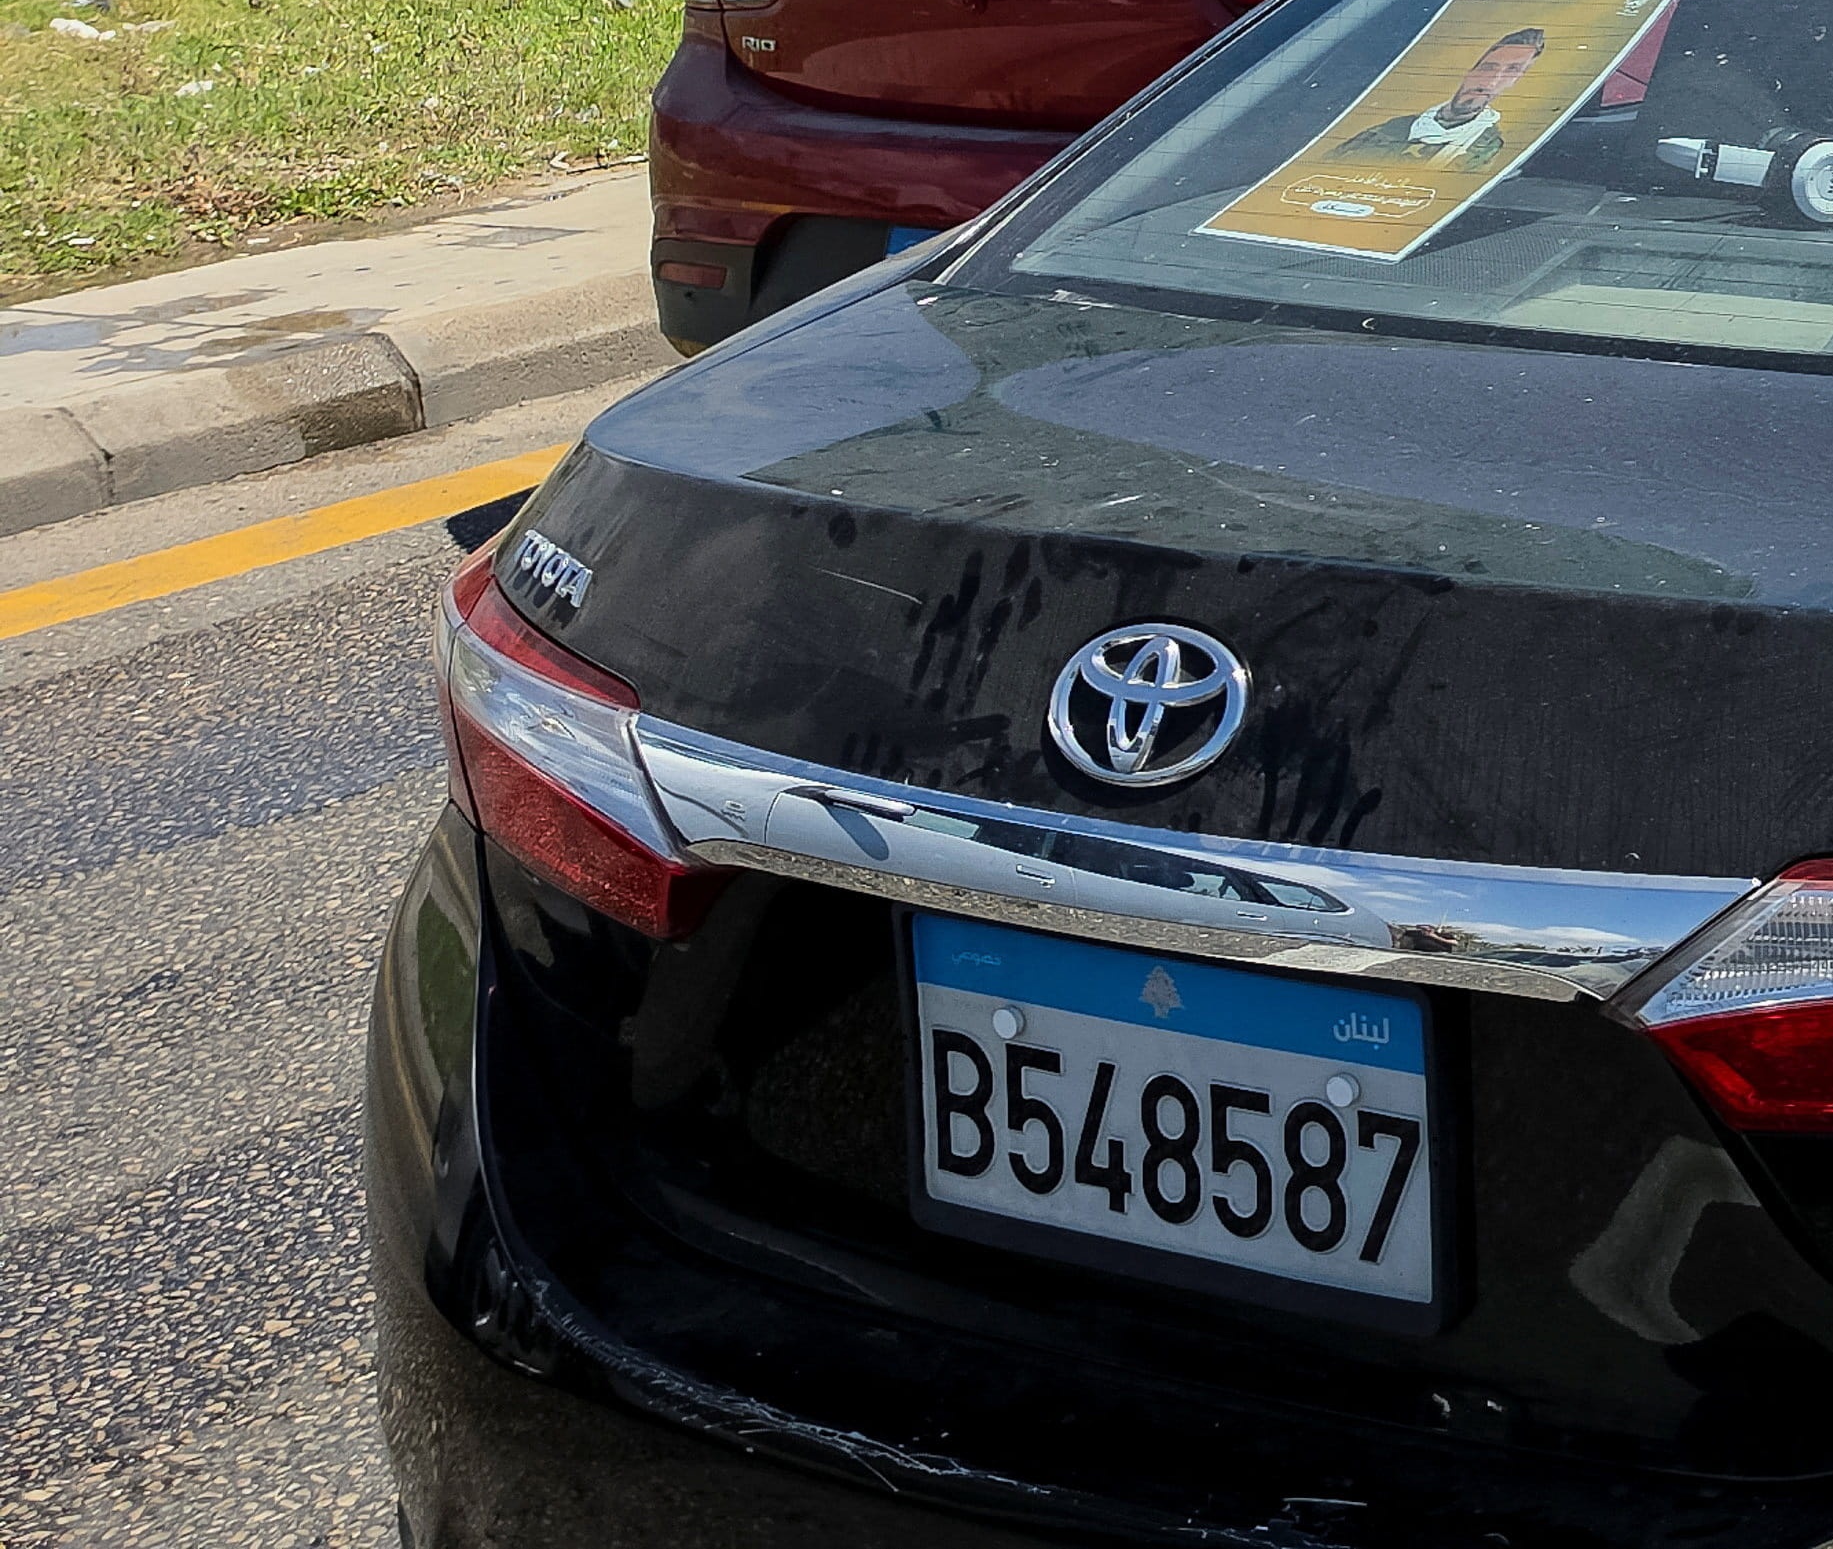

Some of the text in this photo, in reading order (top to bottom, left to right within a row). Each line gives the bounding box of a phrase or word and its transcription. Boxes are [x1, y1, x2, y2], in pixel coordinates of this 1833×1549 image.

[742, 36, 776, 52] RIO
[514, 528, 595, 609] TOYOTA
[1333, 1011, 1390, 1052] لبنان
[931, 1027, 1421, 1265] B548587
